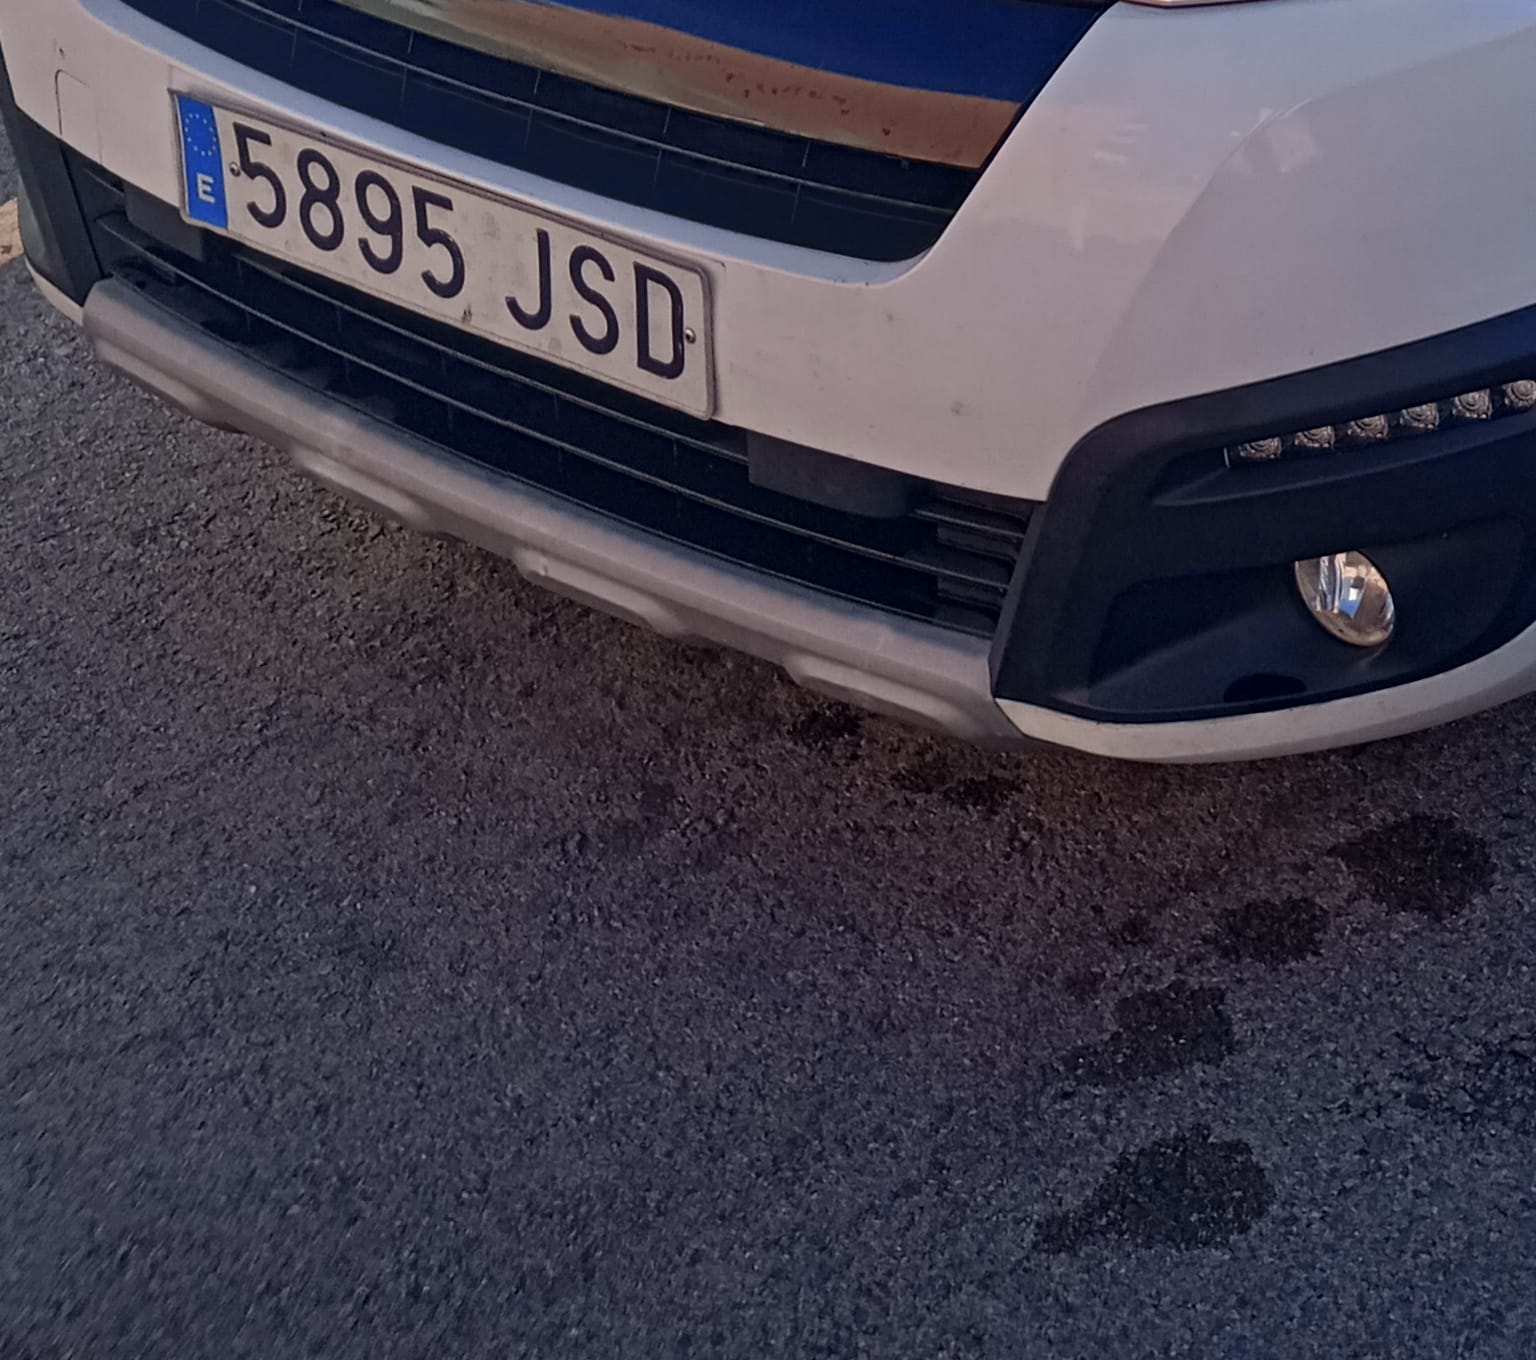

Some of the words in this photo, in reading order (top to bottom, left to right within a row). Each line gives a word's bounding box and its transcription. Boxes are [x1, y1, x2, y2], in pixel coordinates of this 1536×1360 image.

[198, 173, 216, 203] E
[232, 121, 465, 299] 5895
[505, 228, 685, 380] JSD
